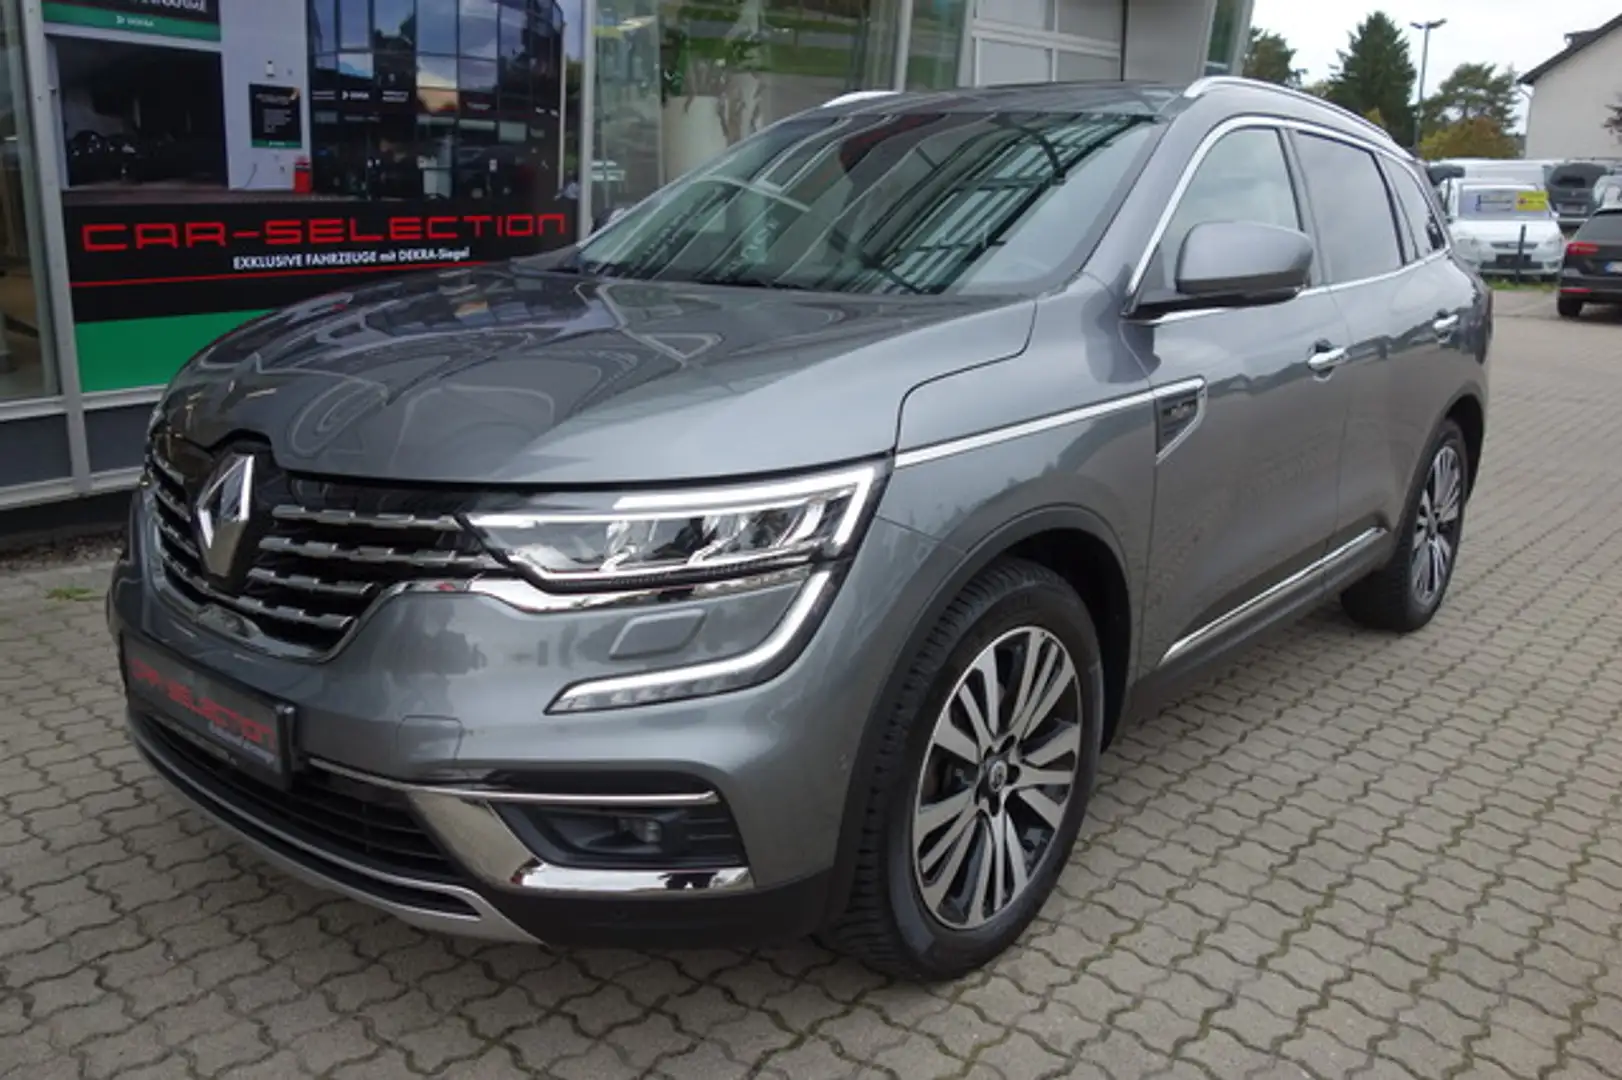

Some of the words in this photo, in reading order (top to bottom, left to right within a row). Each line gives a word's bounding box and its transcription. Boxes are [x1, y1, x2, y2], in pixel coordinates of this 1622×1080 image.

[82, 213, 566, 252] CAR-SELECTION
[232, 254, 302, 270] EXKLUSIVE
[306, 251, 377, 267] FAHRZEUGE
[379, 250, 396, 263] mit
